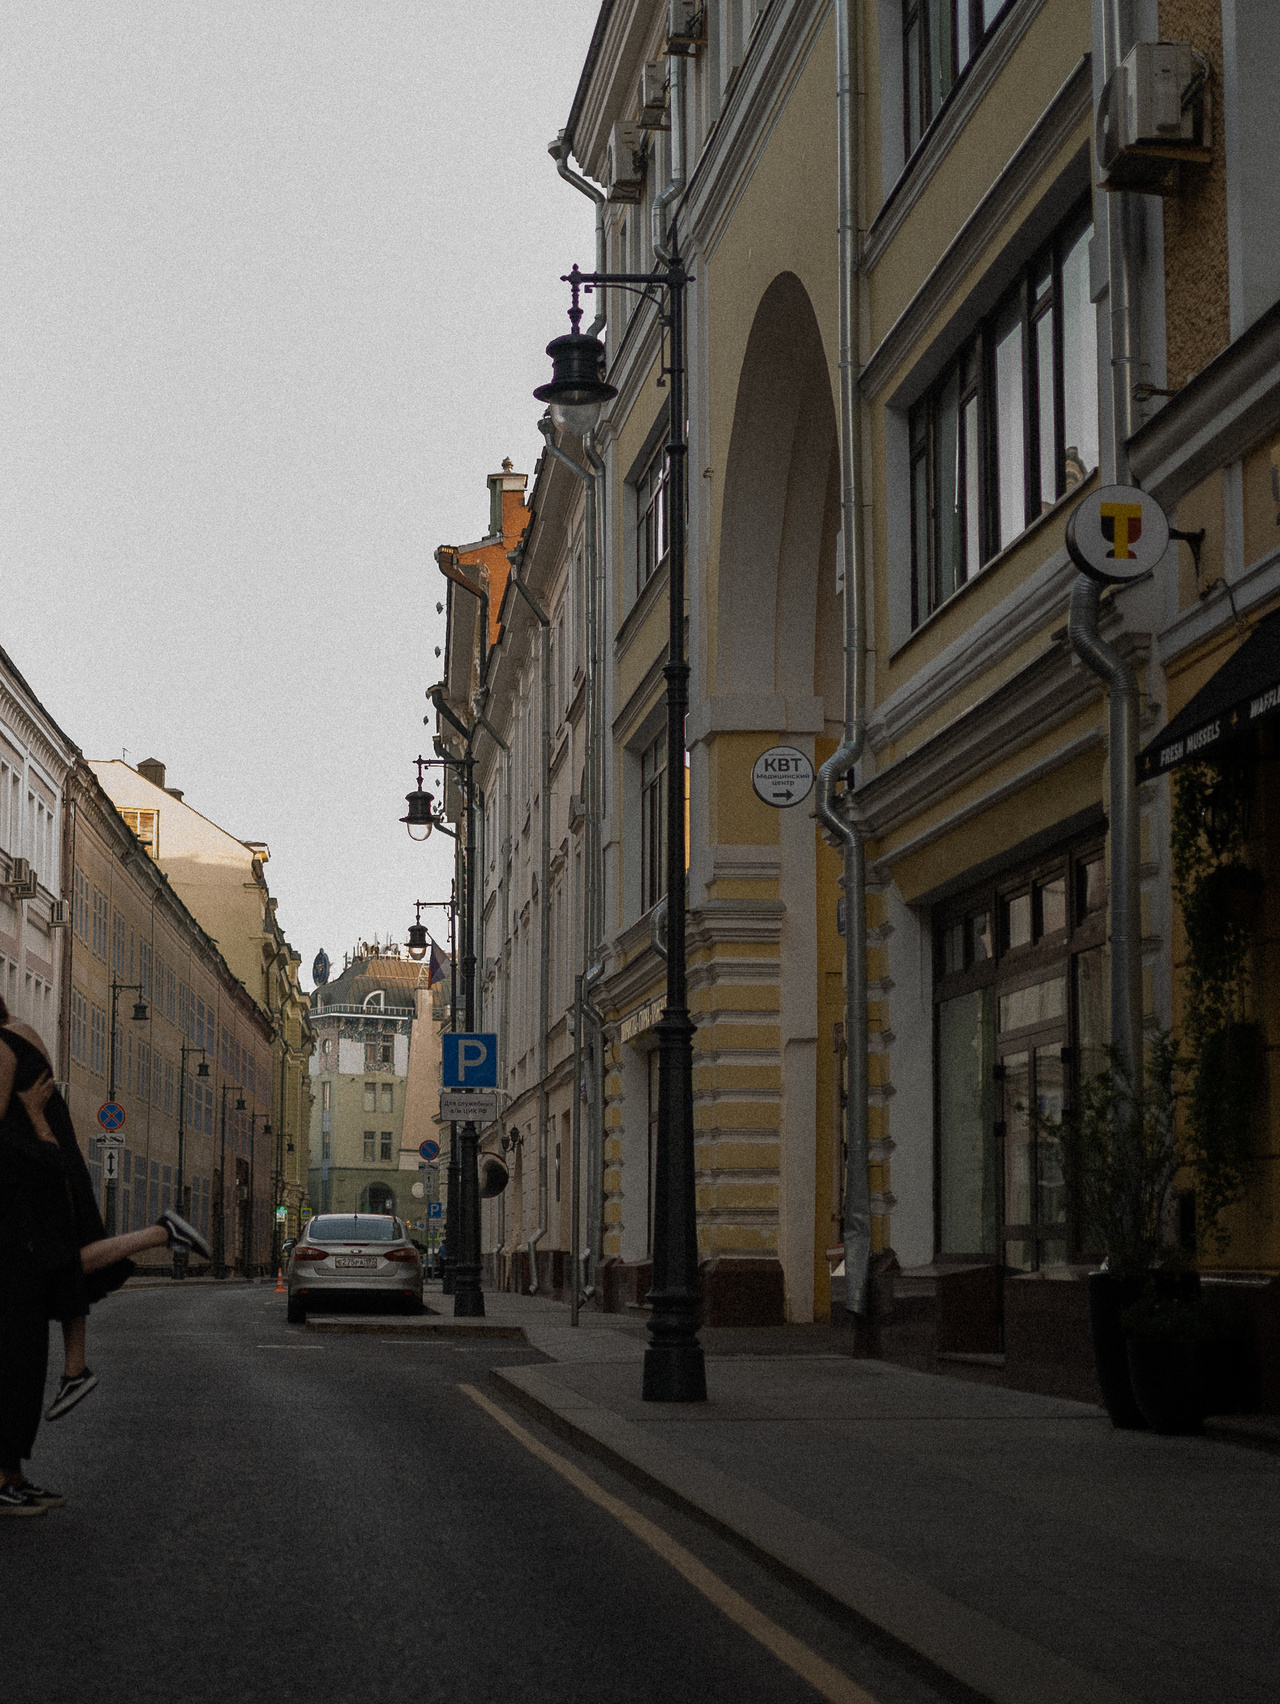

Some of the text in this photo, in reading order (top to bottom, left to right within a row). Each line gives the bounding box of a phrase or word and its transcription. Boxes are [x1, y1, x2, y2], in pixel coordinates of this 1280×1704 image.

[1159, 740, 1184, 767] FRESH
[1186, 719, 1221, 754] MUSSELS
[764, 758, 802, 772] КВТ
[457, 1039, 488, 1082] P
[430, 1203, 440, 1217] P
